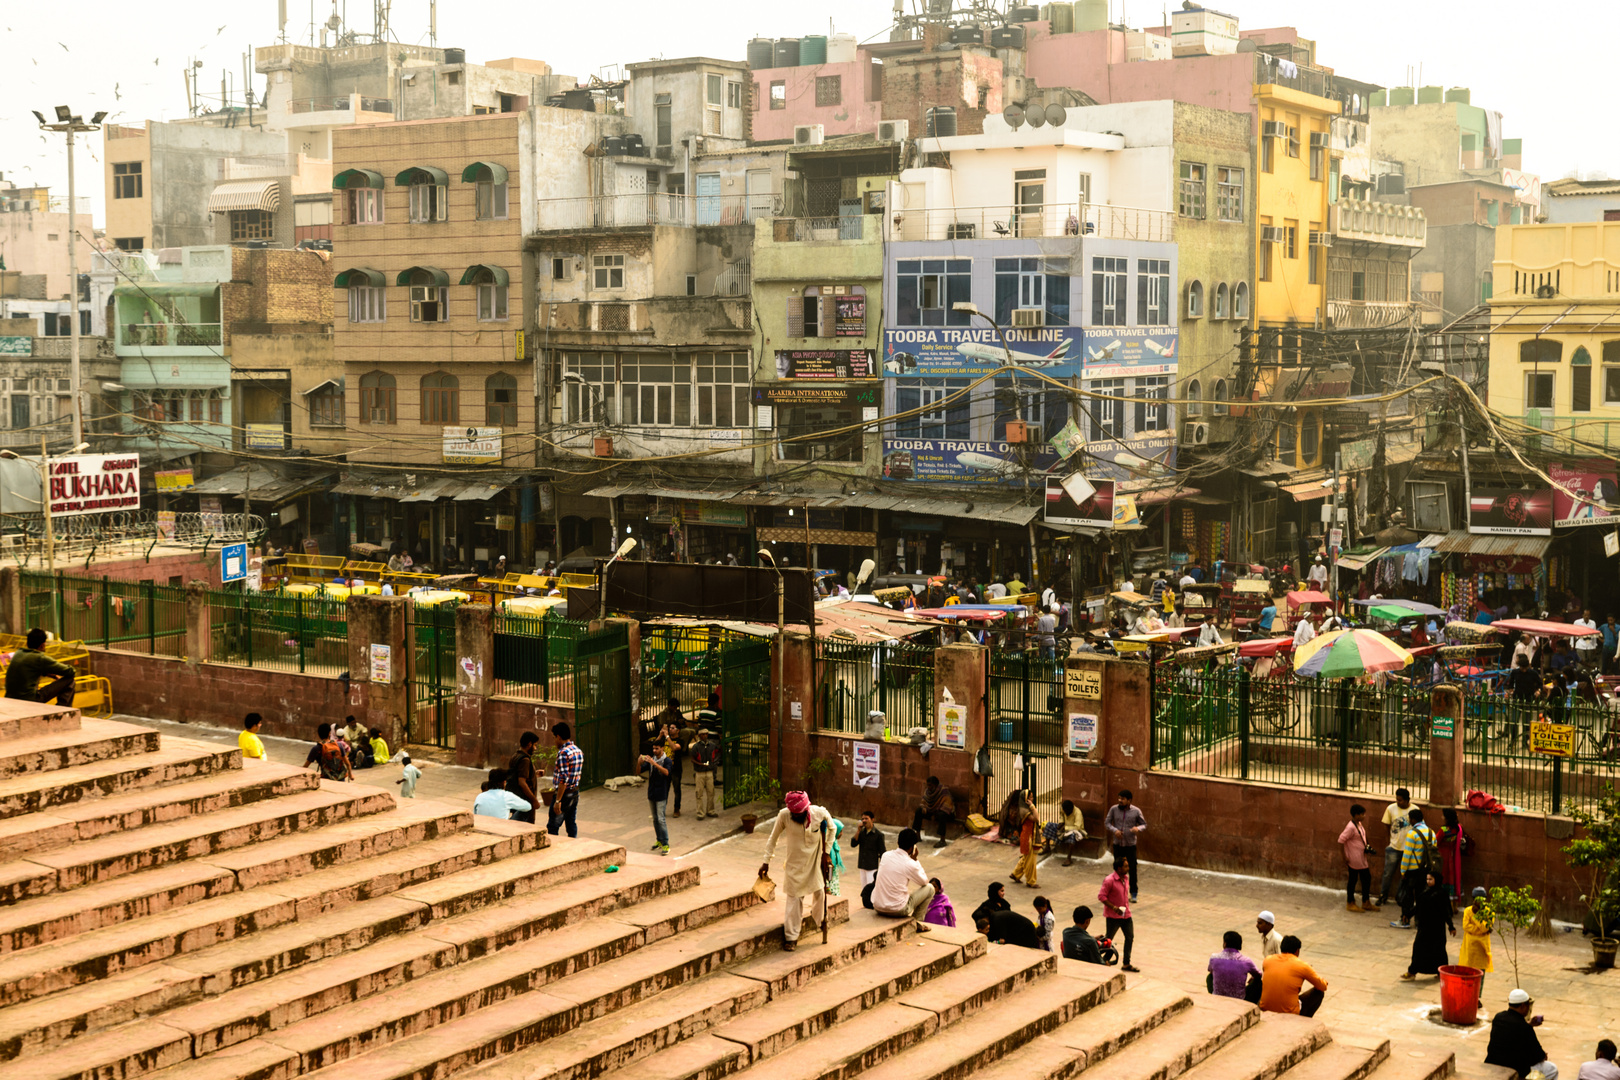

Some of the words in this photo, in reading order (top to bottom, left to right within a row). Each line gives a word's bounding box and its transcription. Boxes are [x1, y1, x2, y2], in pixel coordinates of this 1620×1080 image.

[886, 330, 937, 343] TOOBA
[941, 330, 1000, 342] TRAVEL
[1005, 329, 1064, 343] ONLINE
[1084, 330, 1113, 338] TOOBA
[1149, 328, 1178, 336] ONLINE
[451, 442, 492, 450] JUNAID
[885, 440, 934, 450] TOOBA
[938, 442, 994, 452] TRAVEL
[1084, 444, 1113, 452] TOOBA
[1115, 442, 1147, 450] TRAVEL
[1149, 438, 1179, 448] ONLINE
[49, 462, 80, 475] HOTEL
[50, 472, 138, 500] BUKHARA
[1068, 684, 1099, 694] TOILETS
[1432, 730, 1453, 738] LADIES
[1532, 732, 1570, 742] TOILET
